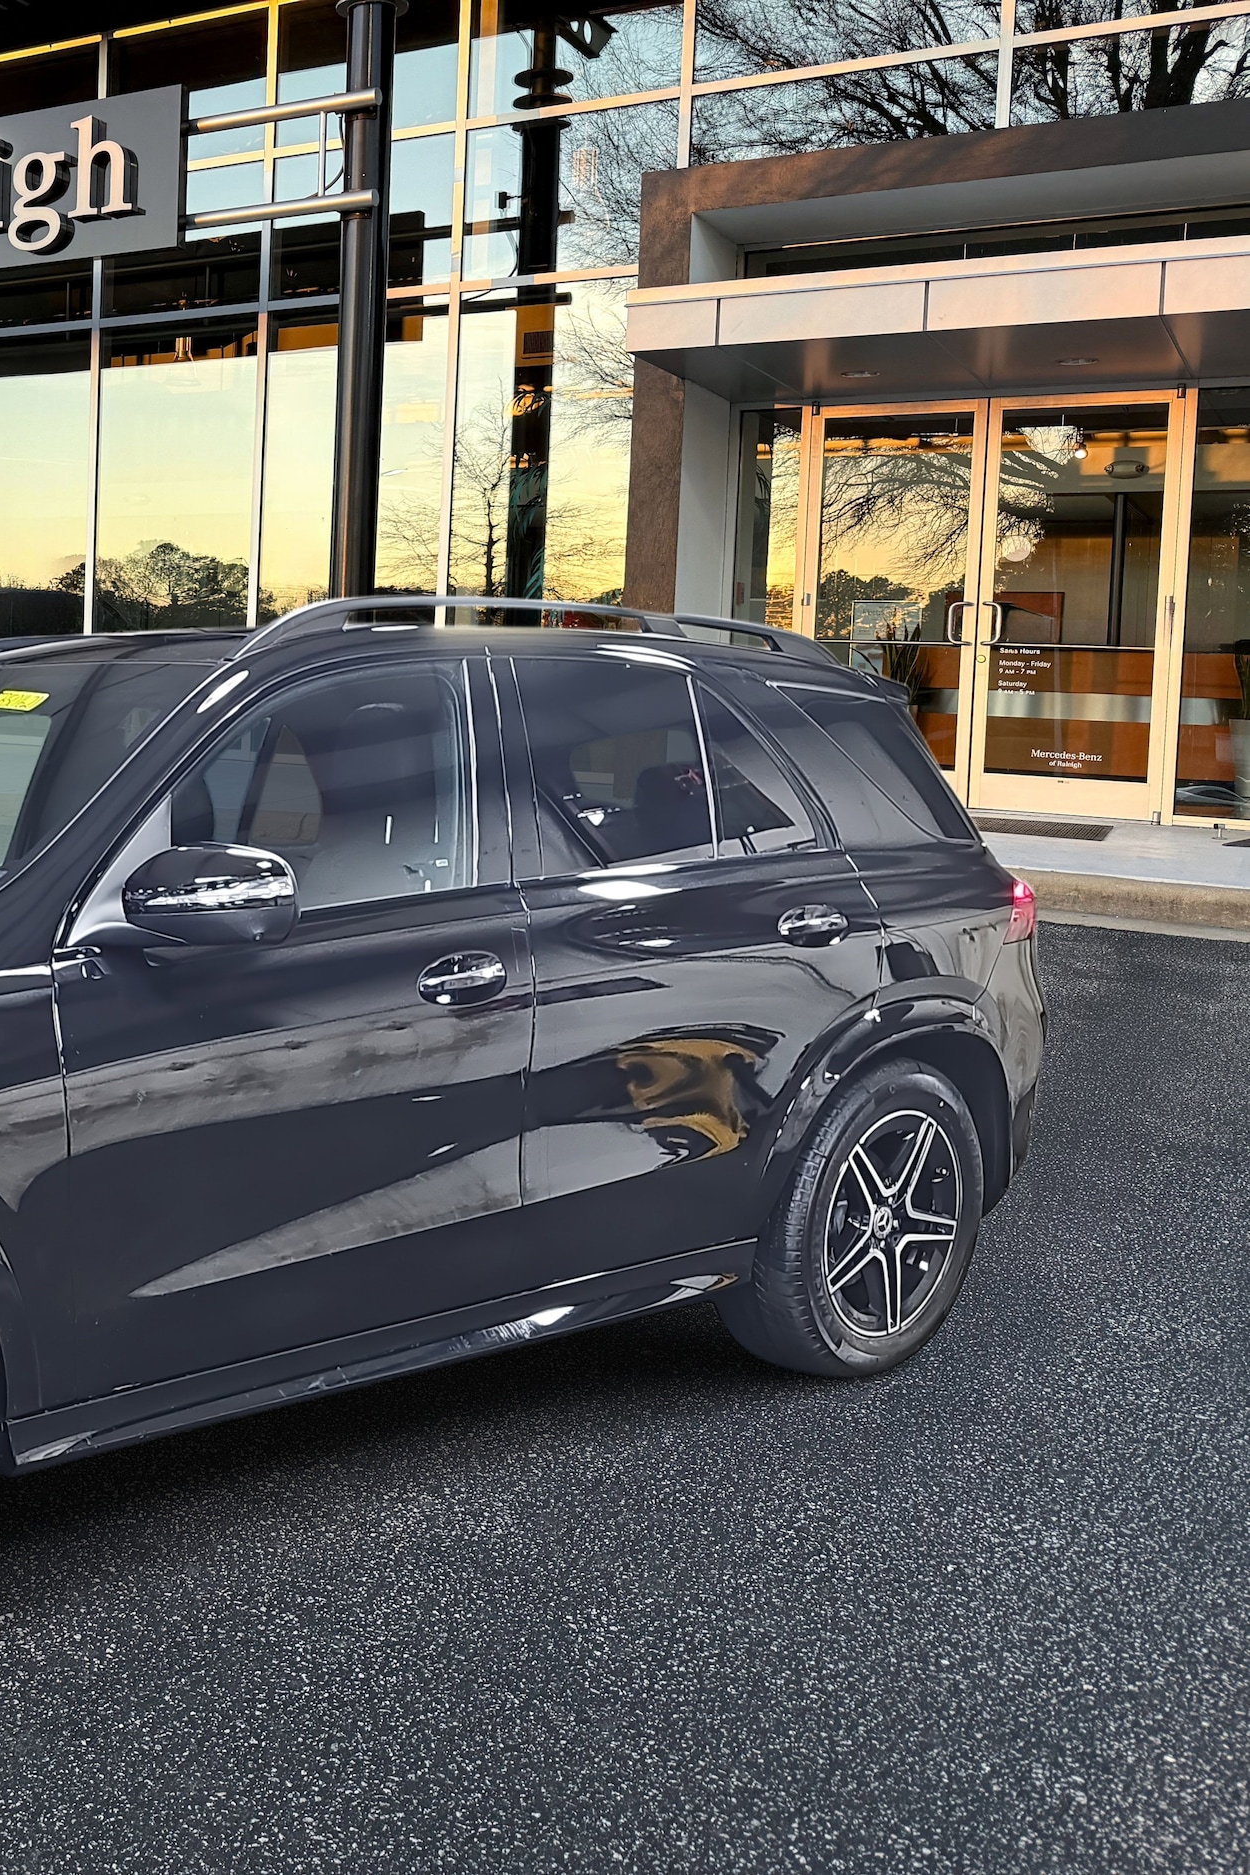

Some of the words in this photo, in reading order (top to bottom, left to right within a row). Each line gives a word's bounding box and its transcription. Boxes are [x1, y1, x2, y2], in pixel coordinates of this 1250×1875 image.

[999, 660, 1025, 668] Monday
[998, 680, 1027, 688] Saturday
[1030, 749, 1103, 762] Mercedes-Benz
